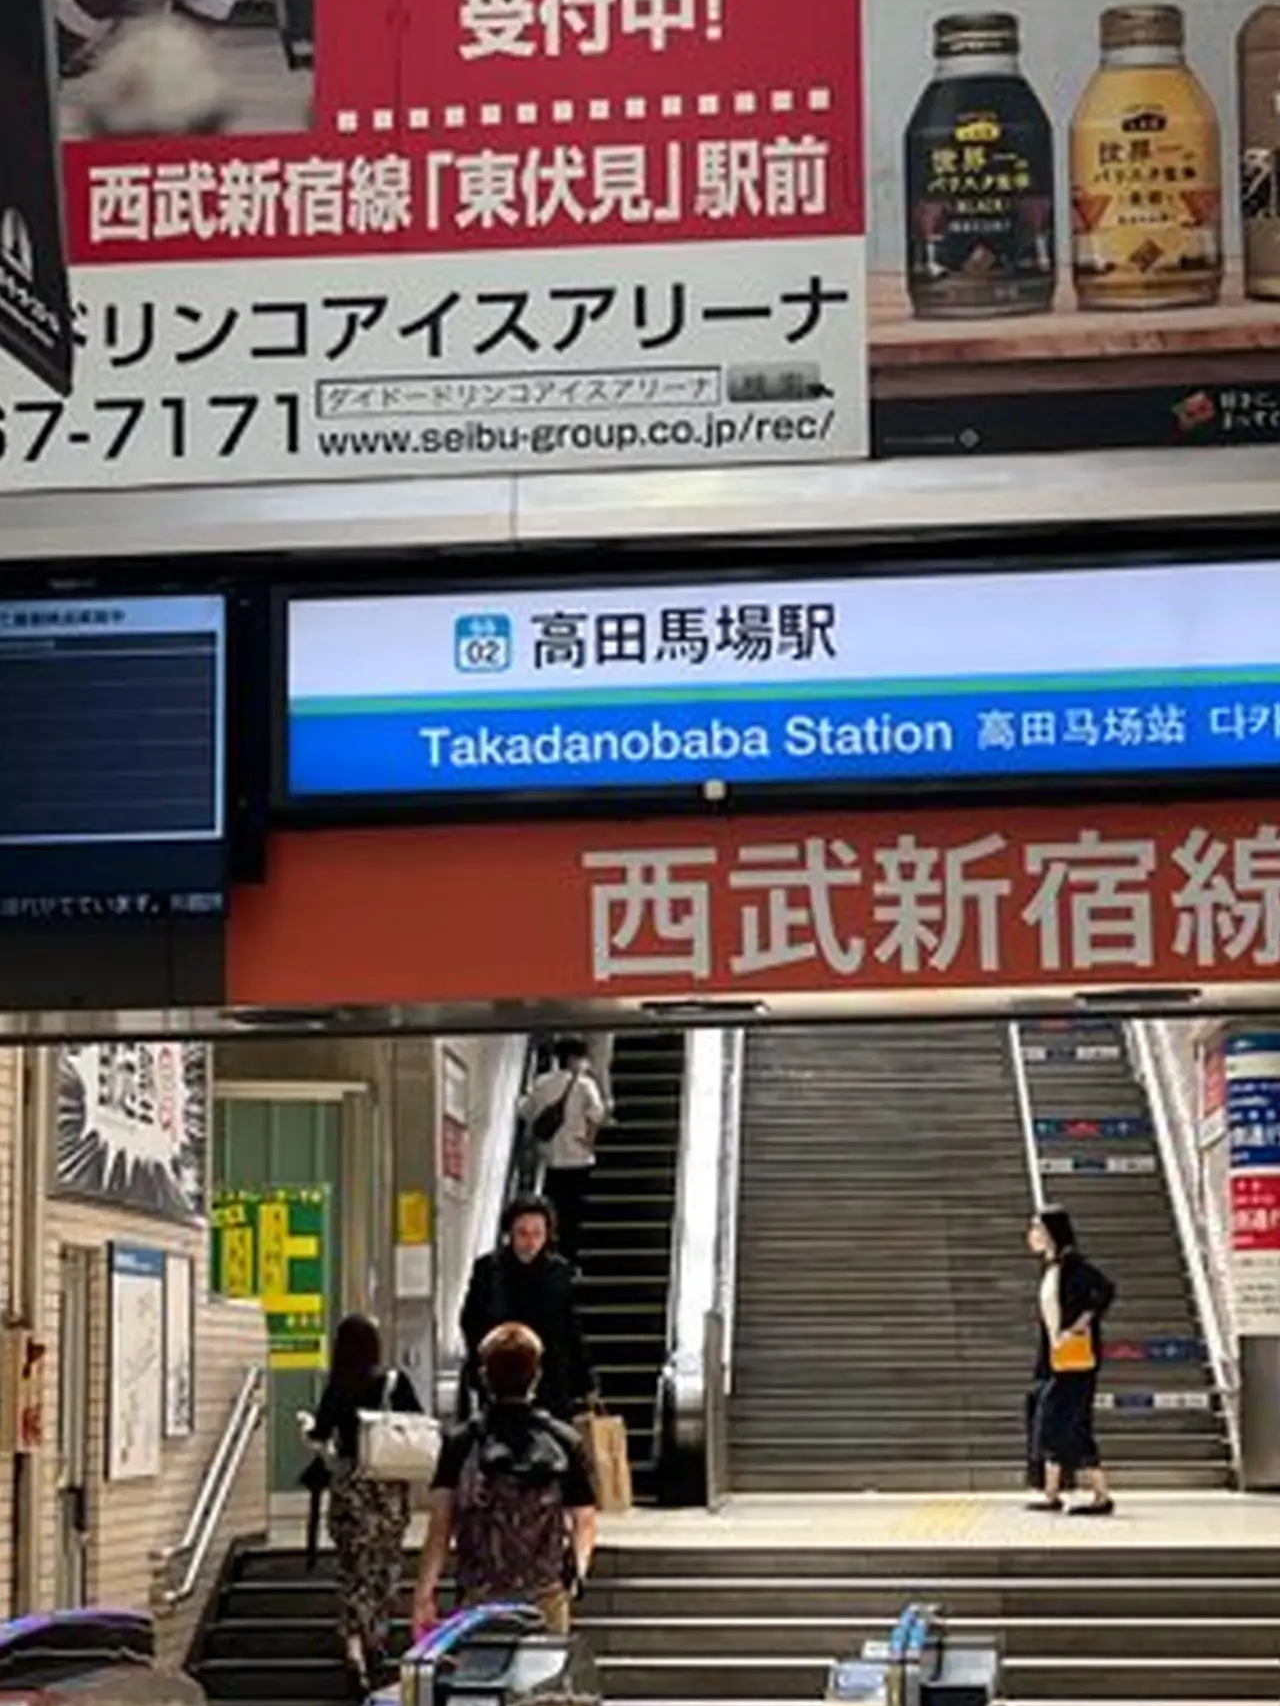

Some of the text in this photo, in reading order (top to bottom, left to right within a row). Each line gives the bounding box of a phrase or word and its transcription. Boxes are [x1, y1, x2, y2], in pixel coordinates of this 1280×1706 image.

[87, 137, 829, 245] 西武新宿線「東伏見」駅前
[320, 408, 837, 457] www.seibu-group.co.jp/rec/
[466, 639, 501, 665] 02
[530, 602, 838, 670] 高田馬場駅
[420, 713, 954, 770] Takadanobaba Station
[977, 703, 1187, 751] 高田马场站
